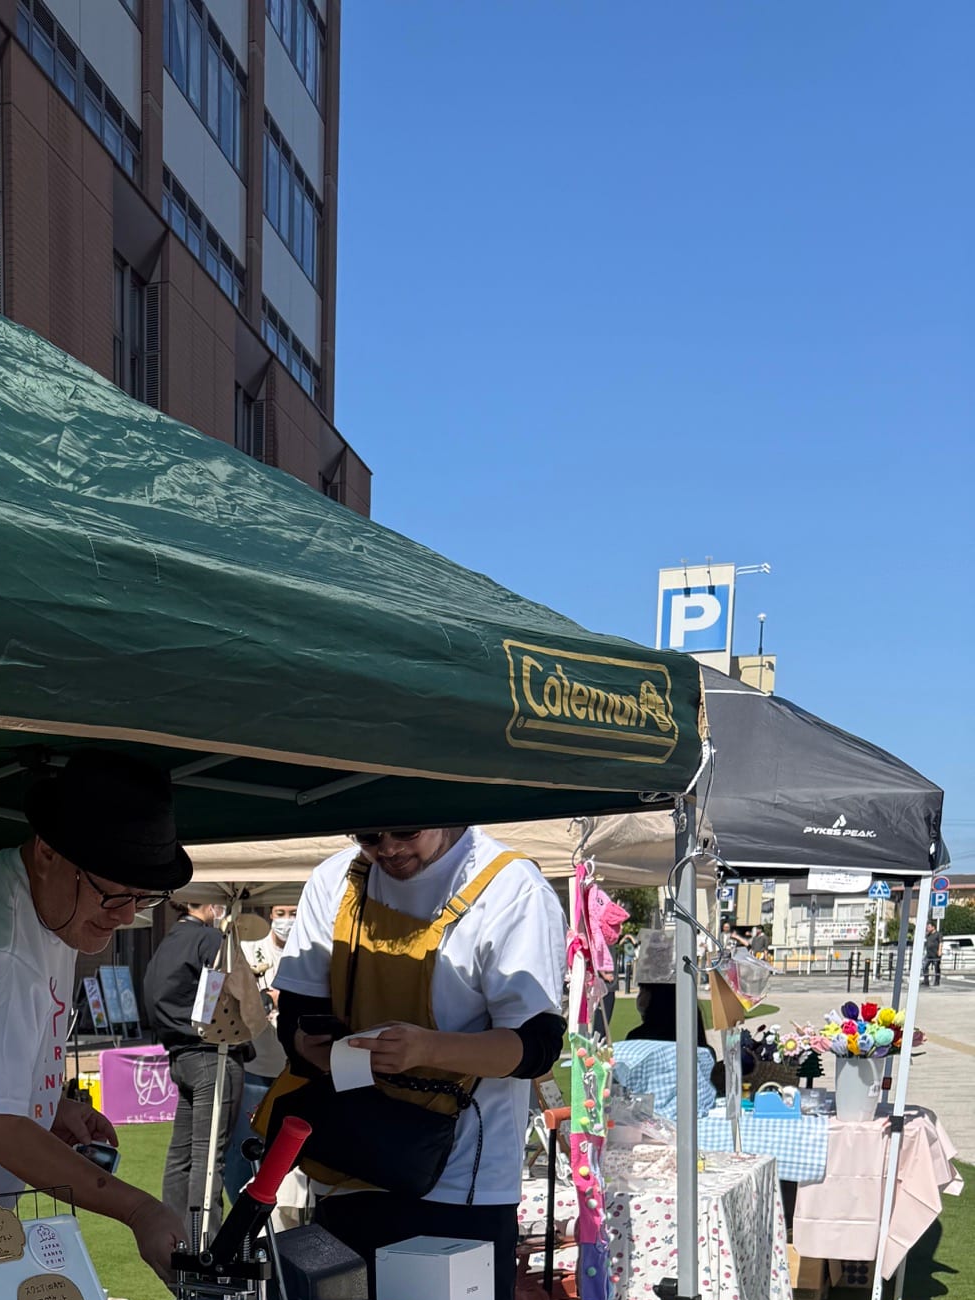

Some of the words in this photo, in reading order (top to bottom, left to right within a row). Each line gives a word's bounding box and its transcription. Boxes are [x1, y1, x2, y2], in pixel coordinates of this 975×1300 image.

[669, 593, 721, 648] P
[523, 655, 647, 728] Coleman
[803, 827, 841, 836] PYKES
[935, 894, 946, 907] P
[41, 1243, 60, 1251] JAPAN
